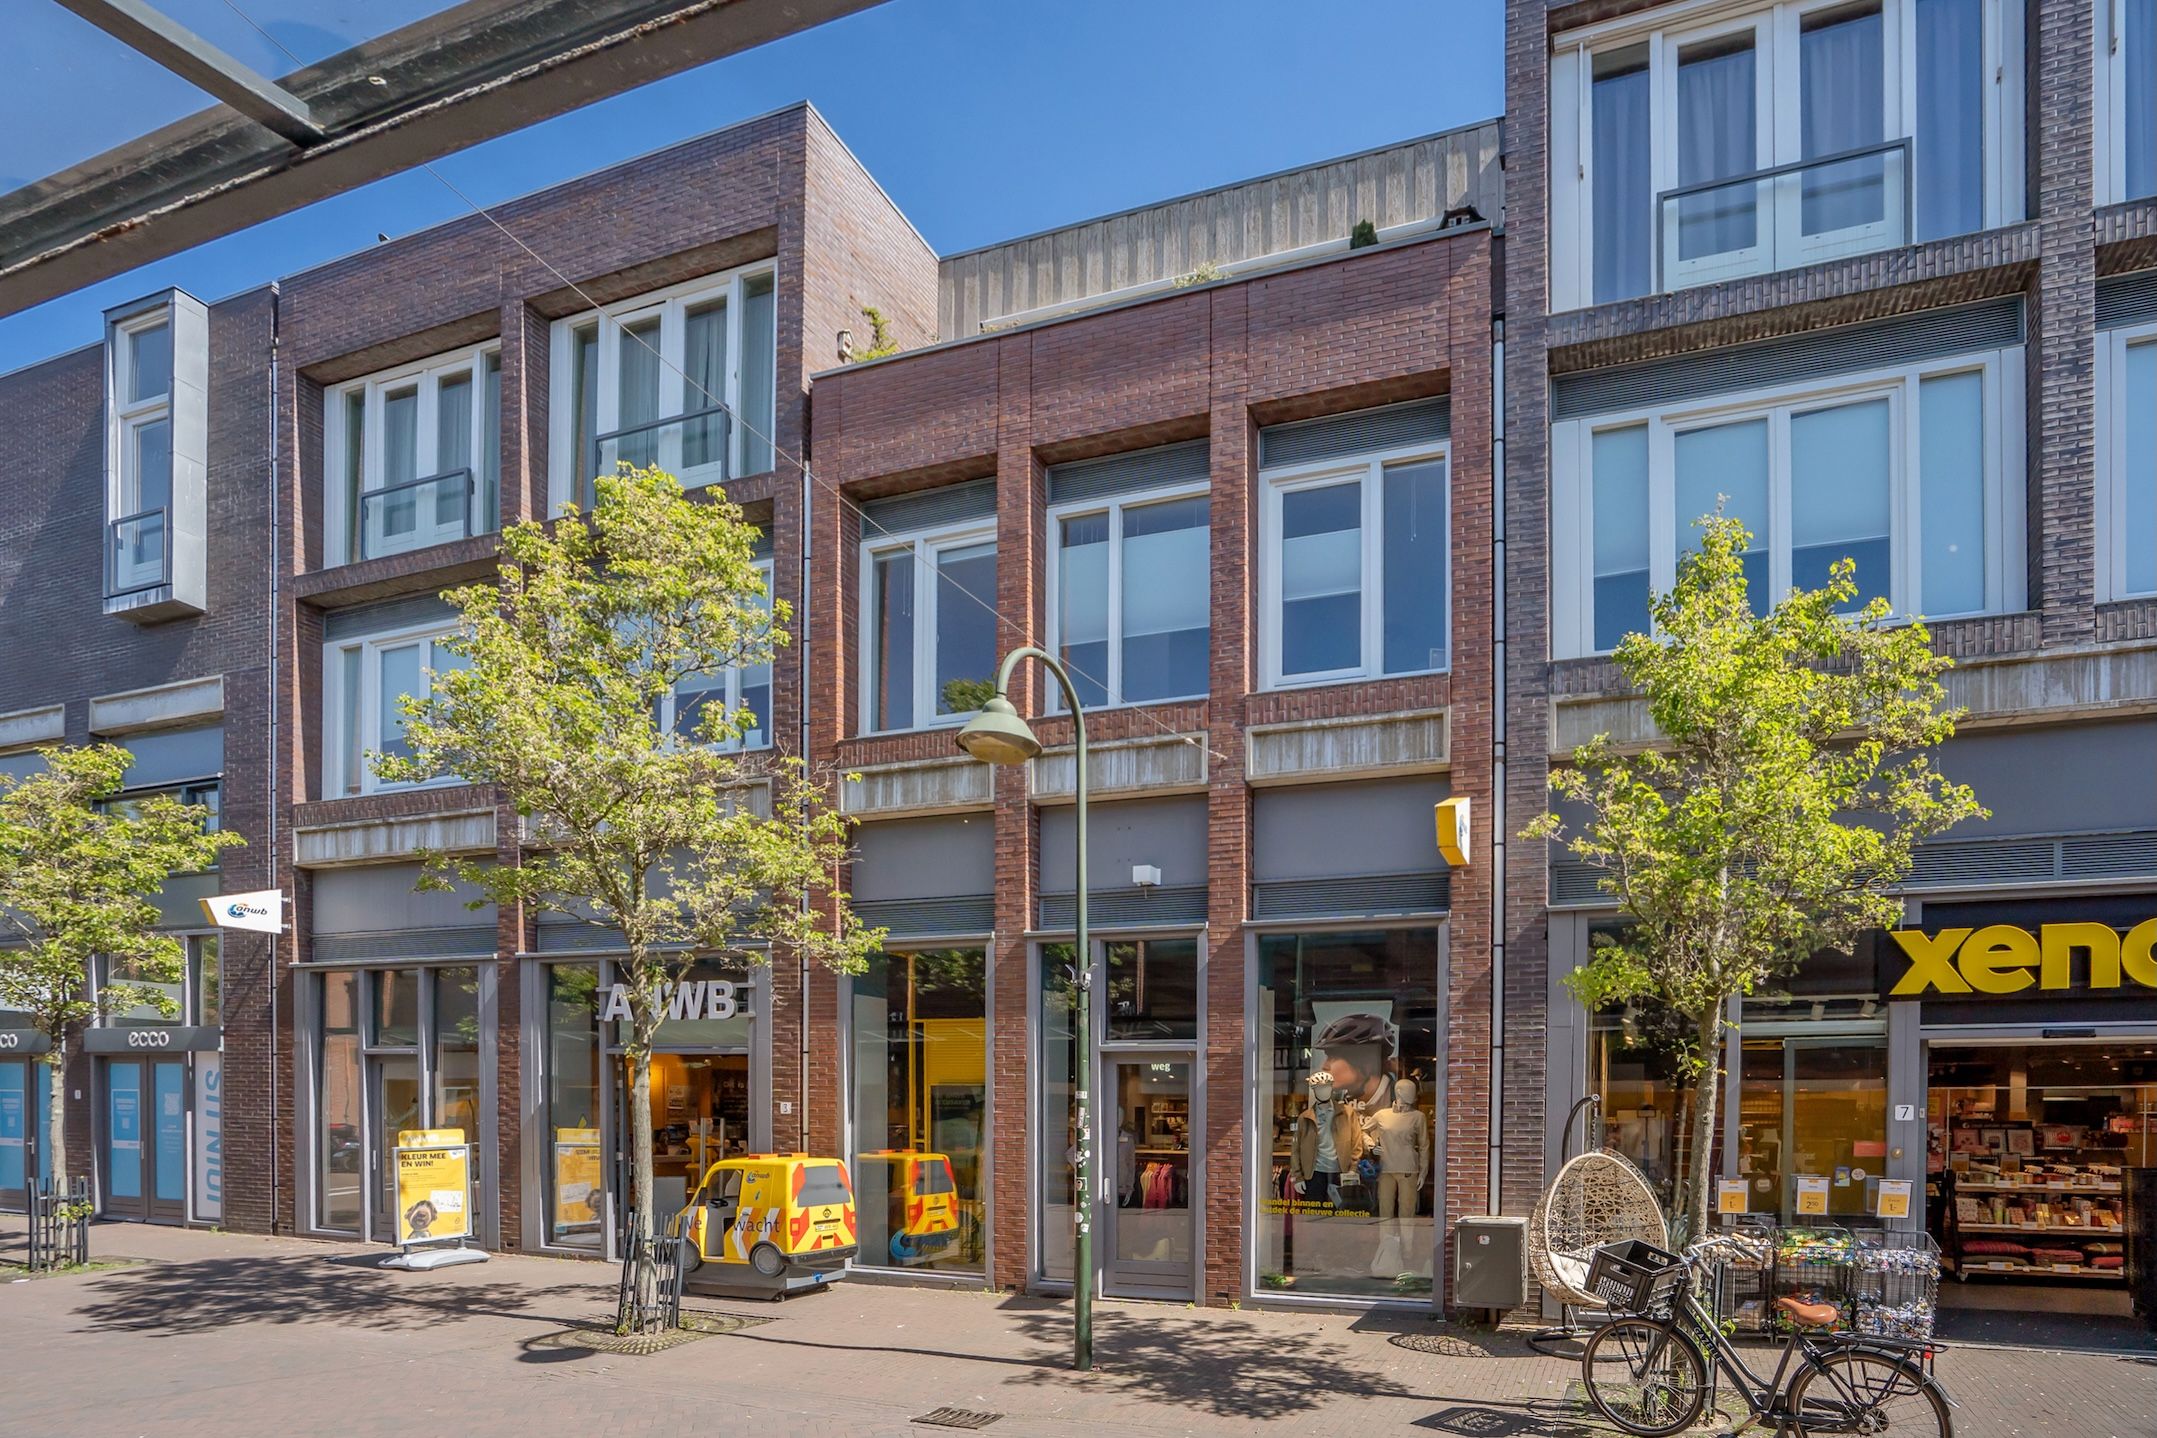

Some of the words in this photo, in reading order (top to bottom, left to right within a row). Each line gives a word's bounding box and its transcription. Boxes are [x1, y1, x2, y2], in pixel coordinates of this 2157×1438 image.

[236, 905, 268, 916] anwb
[128, 1031, 169, 1047] ecco
[1151, 1063, 1171, 1072] weg
[782, 1103, 789, 1112] 3
[1901, 1106, 1909, 1119] 7
[415, 1160, 433, 1168] WIN!
[1292, 1199, 1320, 1207] binnen
[1290, 1206, 1300, 1214] de
[1302, 1208, 1333, 1216] nieuwe
[1335, 1210, 1370, 1218] collectie
[734, 1216, 780, 1232] wacht
[1694, 1326, 1723, 1364] GAZELLE
